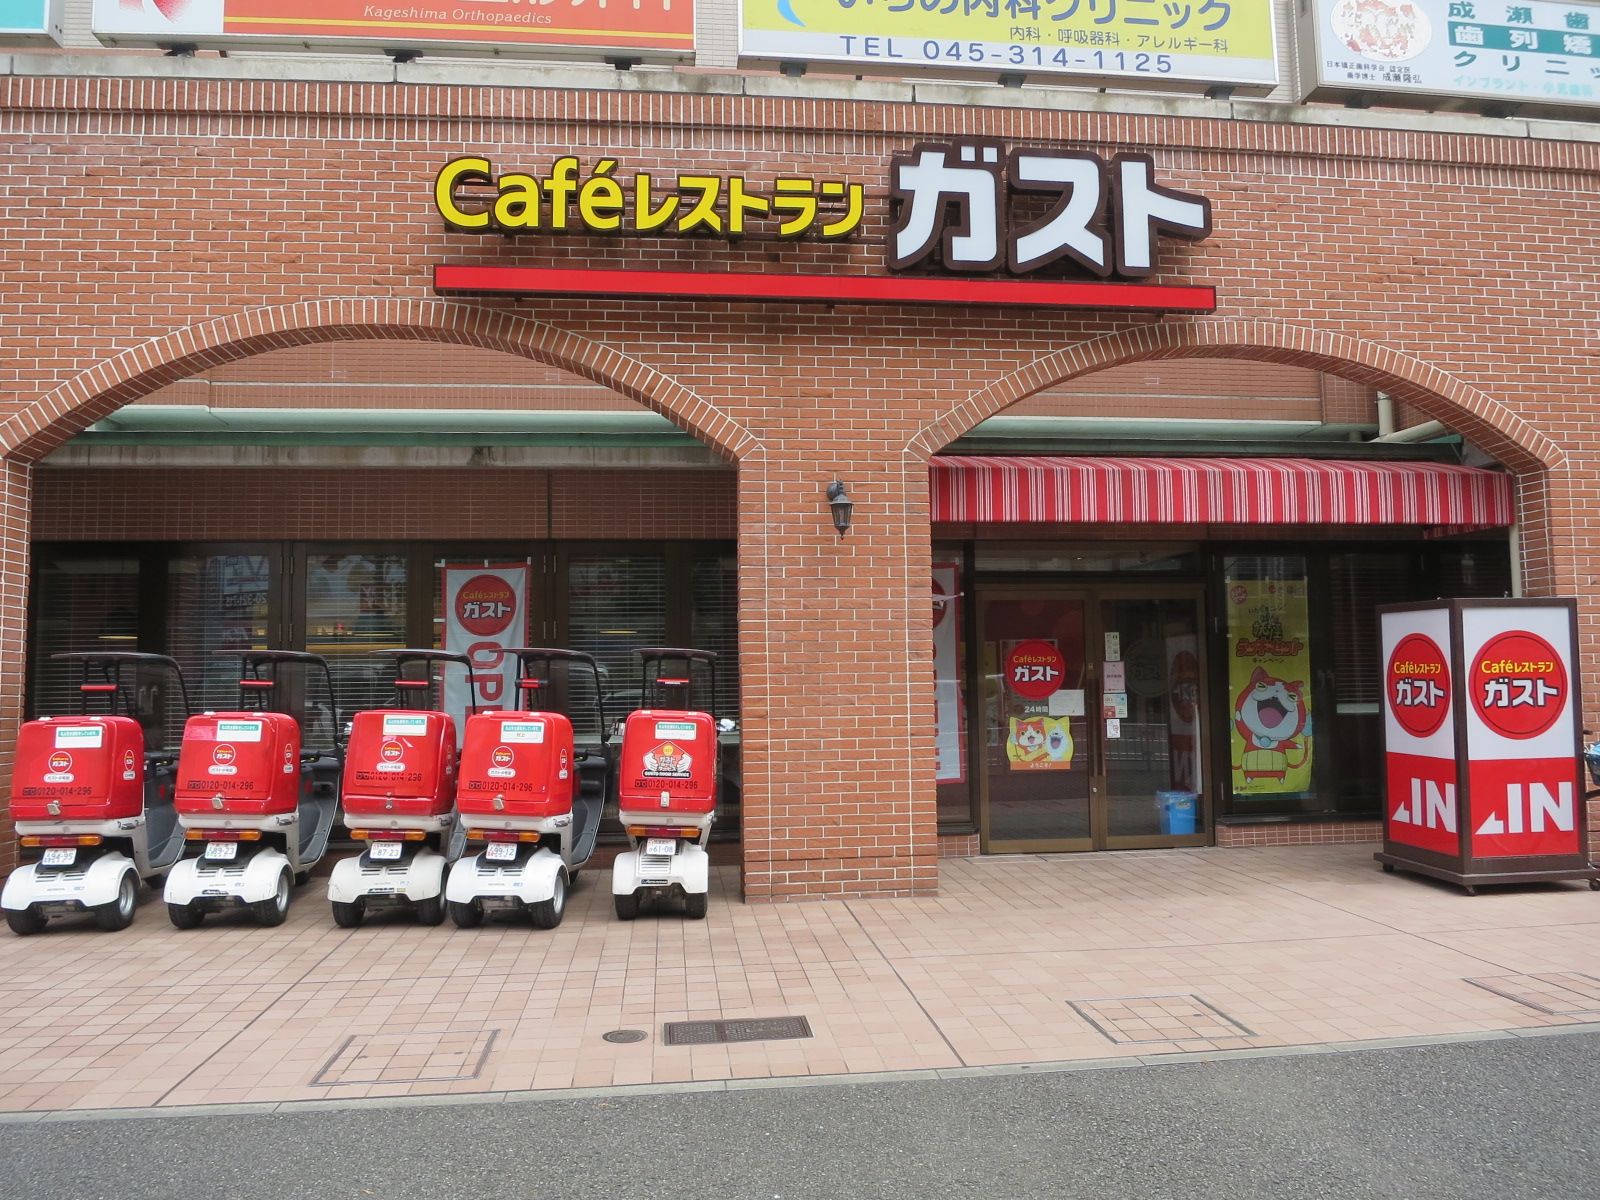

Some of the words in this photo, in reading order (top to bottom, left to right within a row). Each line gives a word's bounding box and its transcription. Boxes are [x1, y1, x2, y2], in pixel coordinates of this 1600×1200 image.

[363, 5, 447, 20] Kageshima
[452, 8, 552, 24] Orthopaedics
[840, 36, 903, 58] TEL
[923, 40, 1172, 73] 045-314-1125
[891, 141, 1209, 272] ガスト
[463, 602, 511, 619] ガスト
[1014, 665, 1059, 682] ガスト
[1396, 679, 1445, 706] ガスト
[1484, 678, 1557, 707] ガスト
[482, 781, 533, 791] 0120-014-296
[648, 780, 698, 789] 0120-014-296
[1411, 777, 1457, 833] IN
[1507, 782, 1574, 833] IN
